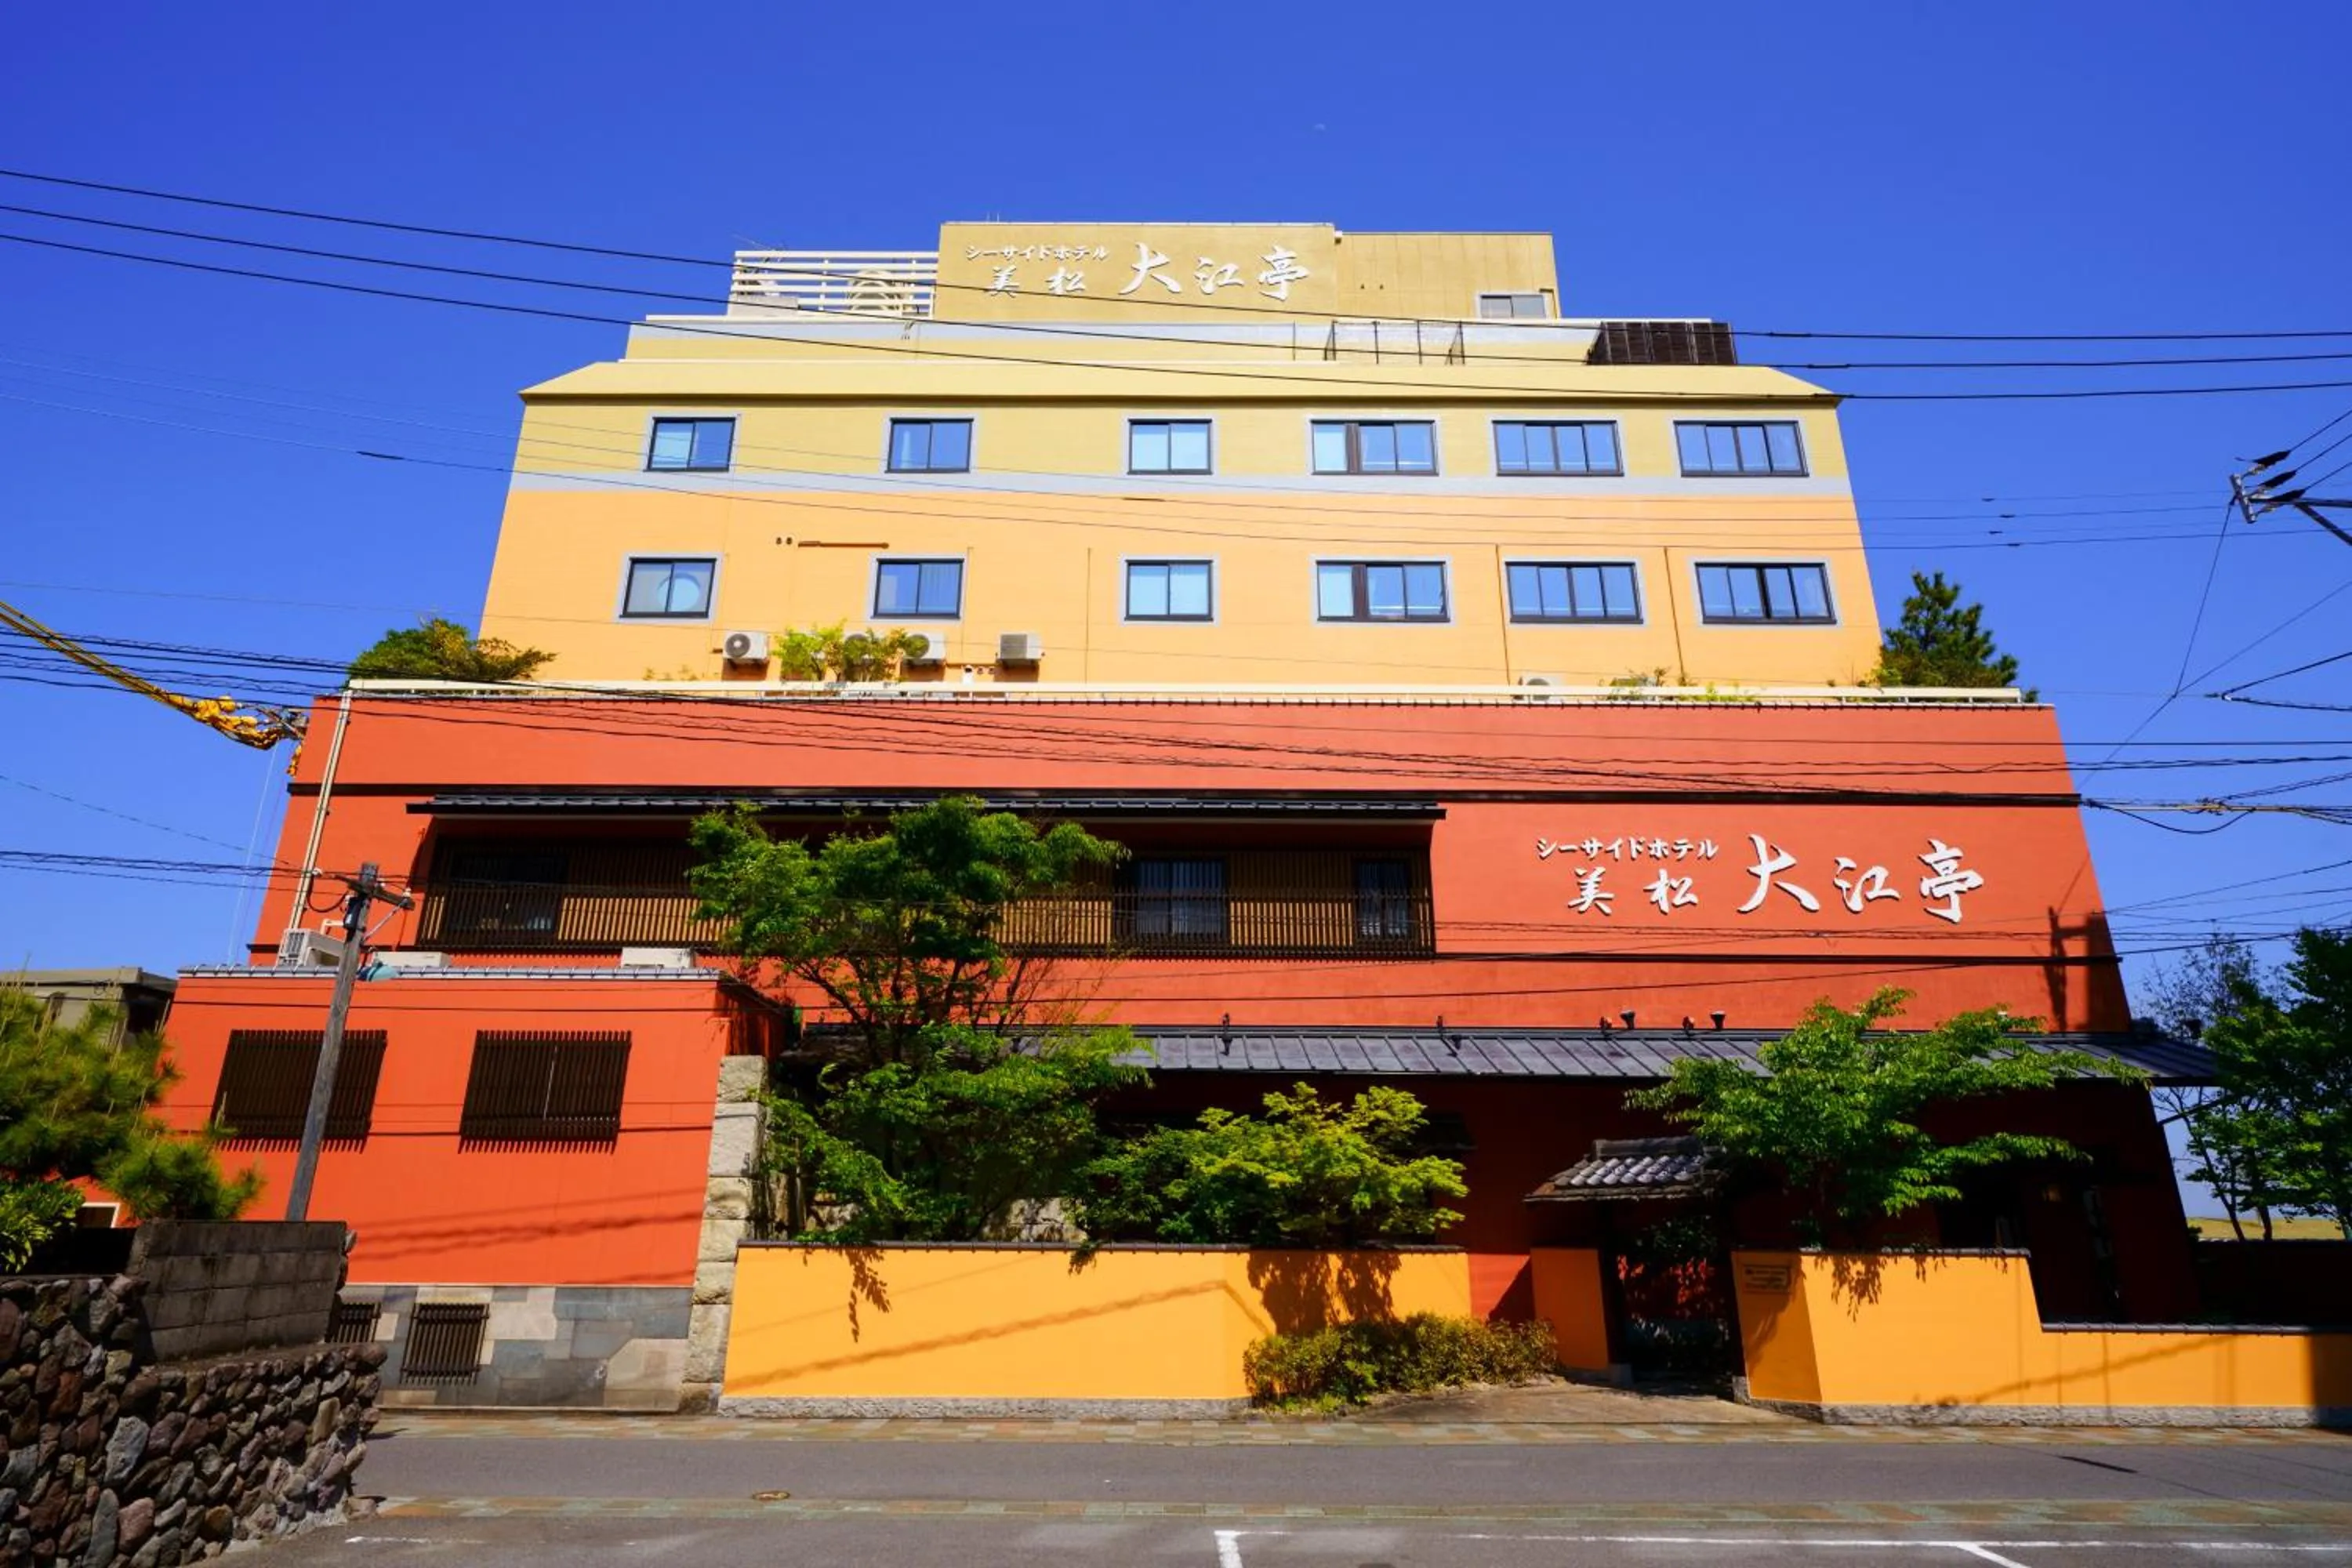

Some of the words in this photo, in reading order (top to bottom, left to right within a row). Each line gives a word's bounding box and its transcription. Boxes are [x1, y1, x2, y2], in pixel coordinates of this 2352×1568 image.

[965, 244, 1109, 263] シーサイドホテル
[984, 265, 1087, 297] 美松
[1118, 241, 1312, 303] 大江亭
[1536, 837, 1719, 859] シーサイドホテル
[1567, 866, 1700, 915] 美松
[1736, 833, 1984, 923] 大江亭
